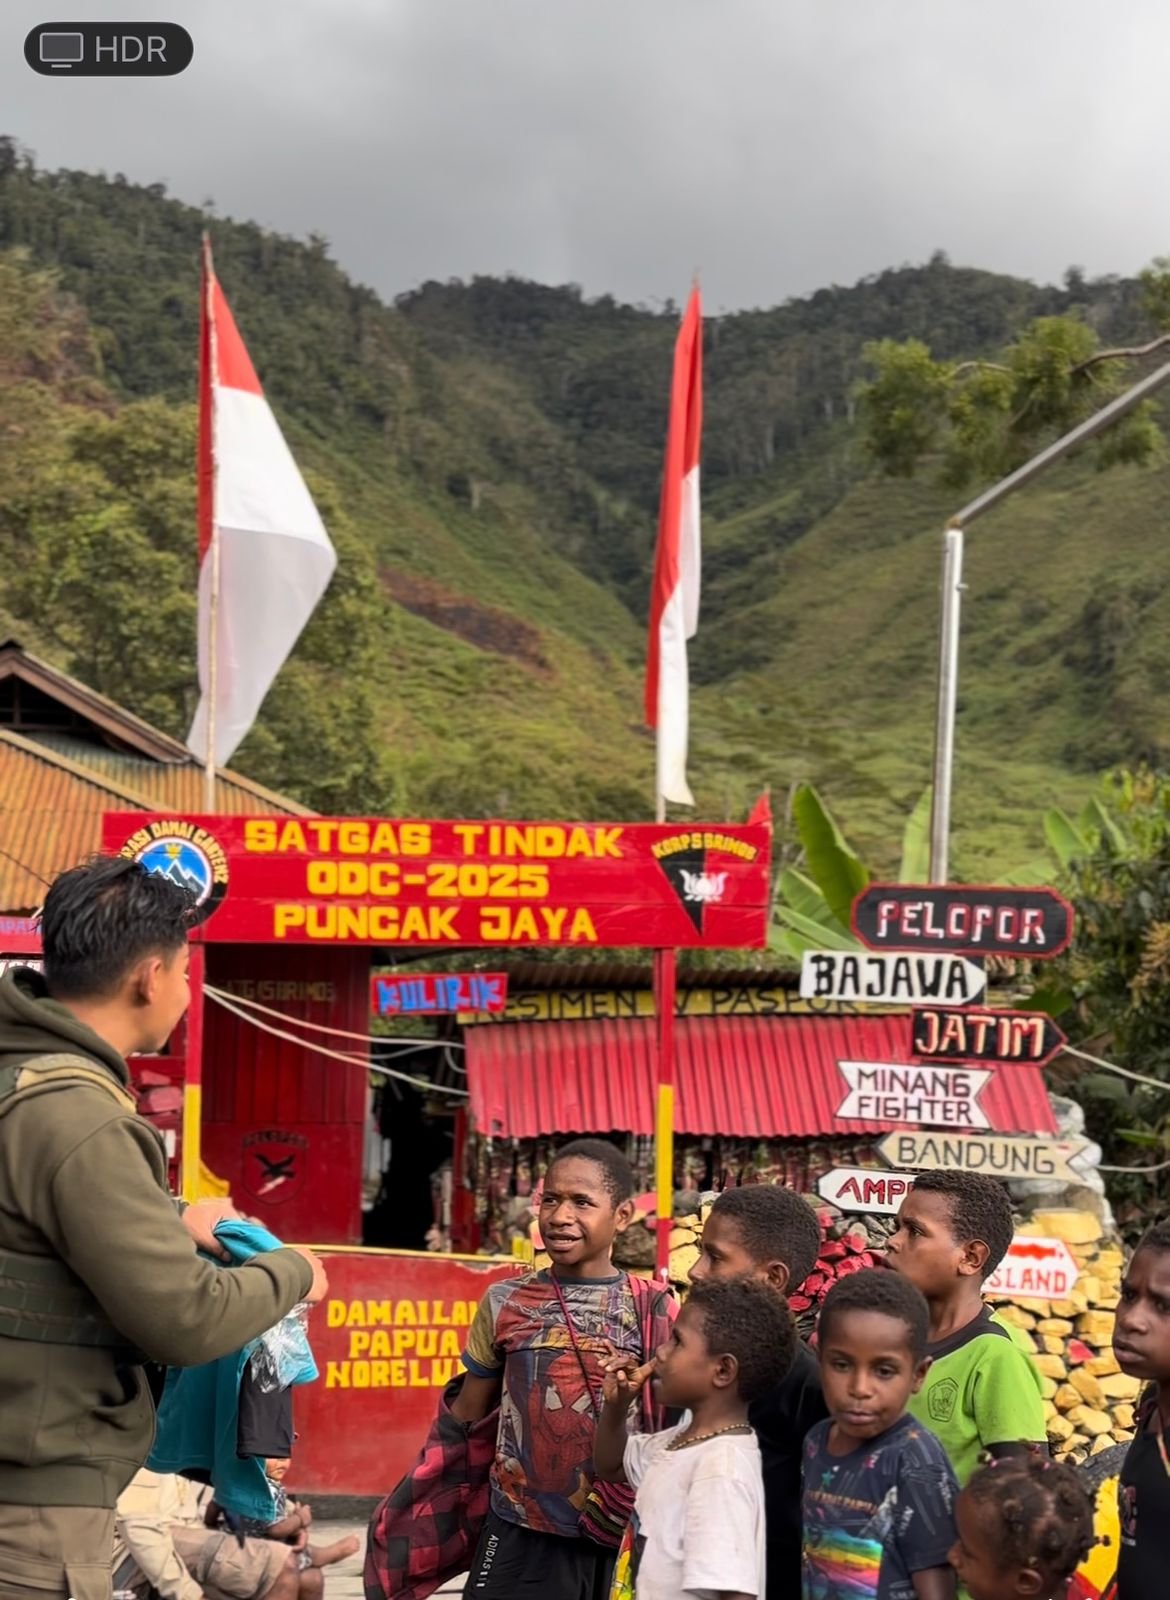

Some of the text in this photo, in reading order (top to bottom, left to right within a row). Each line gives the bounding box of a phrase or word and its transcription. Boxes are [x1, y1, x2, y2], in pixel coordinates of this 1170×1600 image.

[117, 828, 152, 860] RASI
[150, 820, 195, 838] DAMAI
[244, 820, 624, 858] SATGAS TINDAK
[306, 861, 550, 897] ODC-2025
[274, 904, 597, 941] PUNCAK JAYA
[877, 900, 1046, 944] PELOPOR
[811, 954, 968, 998] BAJAWA
[475, 991, 637, 1023] ESIMEN
[915, 1011, 1045, 1057] JATIM
[857, 1067, 972, 1098] MINANG
[857, 1096, 974, 1125] FIGHTER
[897, 1136, 1056, 1175] BANDUNG
[835, 1176, 914, 1205] AMP
[985, 1267, 1067, 1293] SLAND
[348, 1328, 461, 1358] PAPUA
[482, 1533, 500, 1570] ADIDAS
